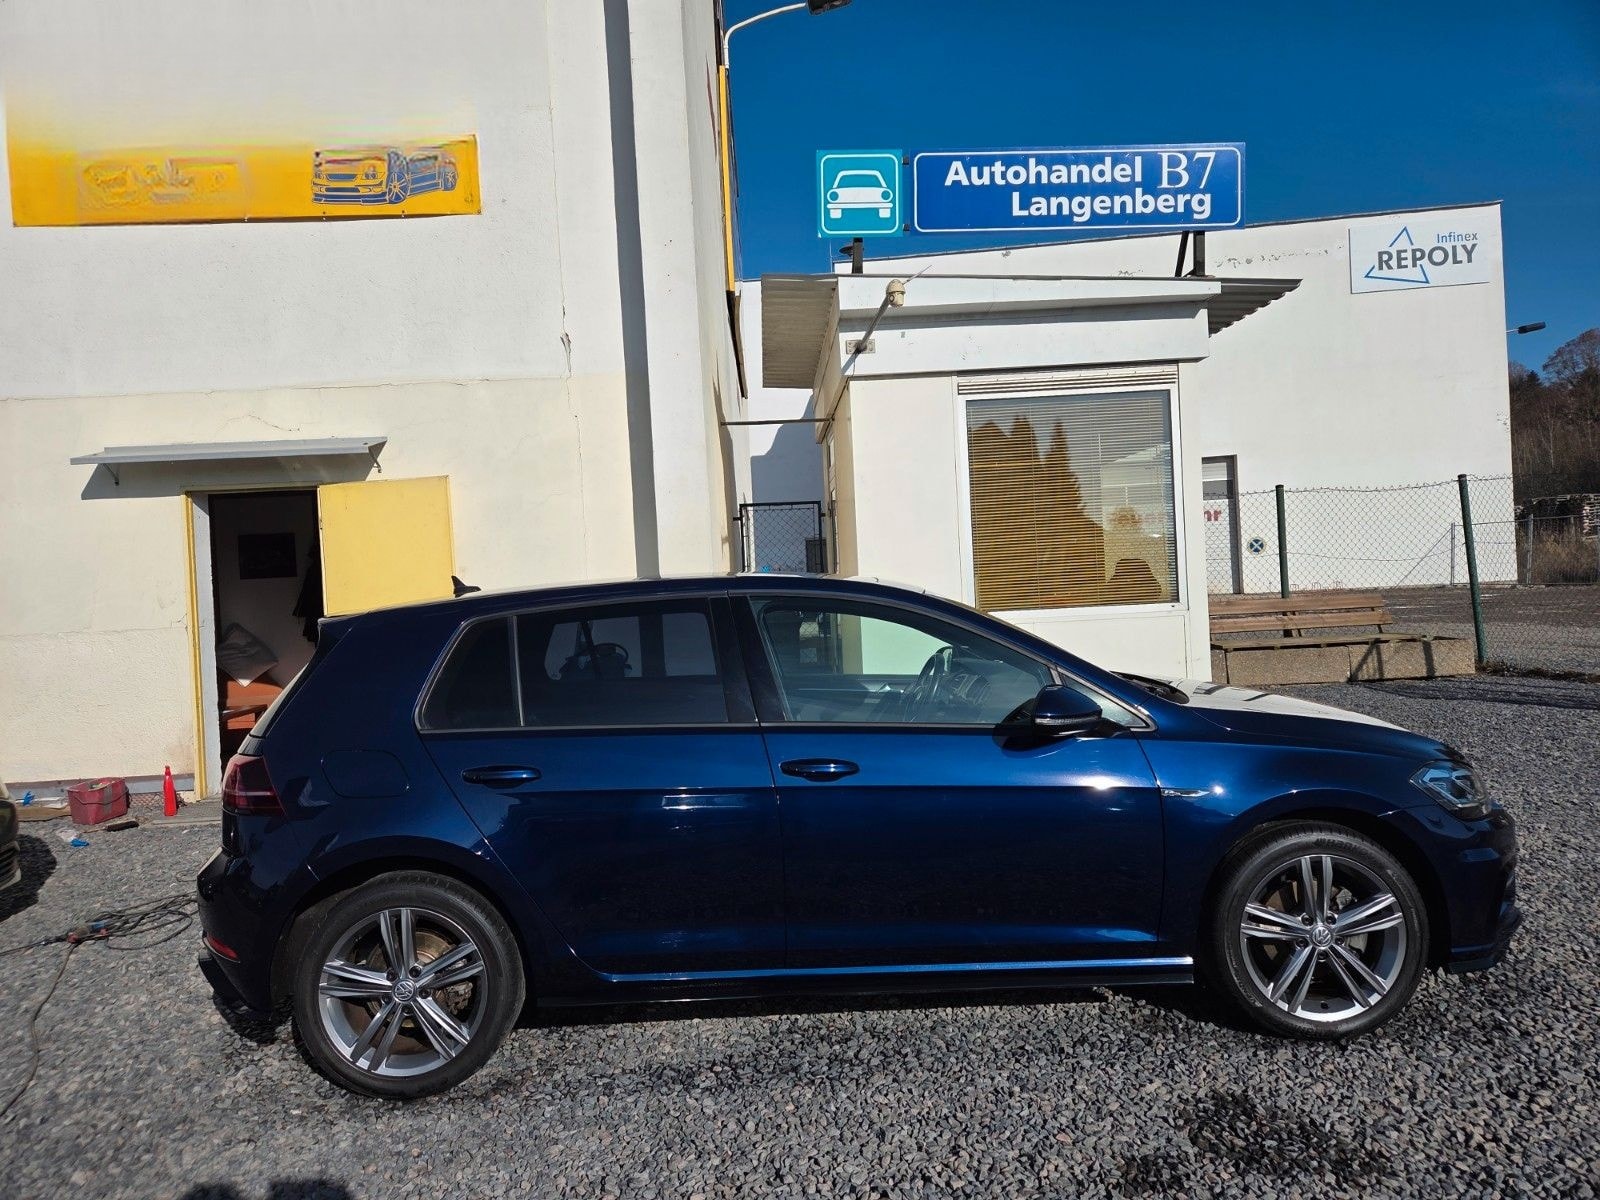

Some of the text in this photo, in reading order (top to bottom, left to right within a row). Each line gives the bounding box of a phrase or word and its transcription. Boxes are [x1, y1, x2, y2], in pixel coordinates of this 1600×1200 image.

[945, 151, 1217, 189] Autohandel B7
[1012, 188, 1212, 222] Langenberg
[1437, 231, 1478, 244] Infinex
[1377, 243, 1478, 271] REPOLY
